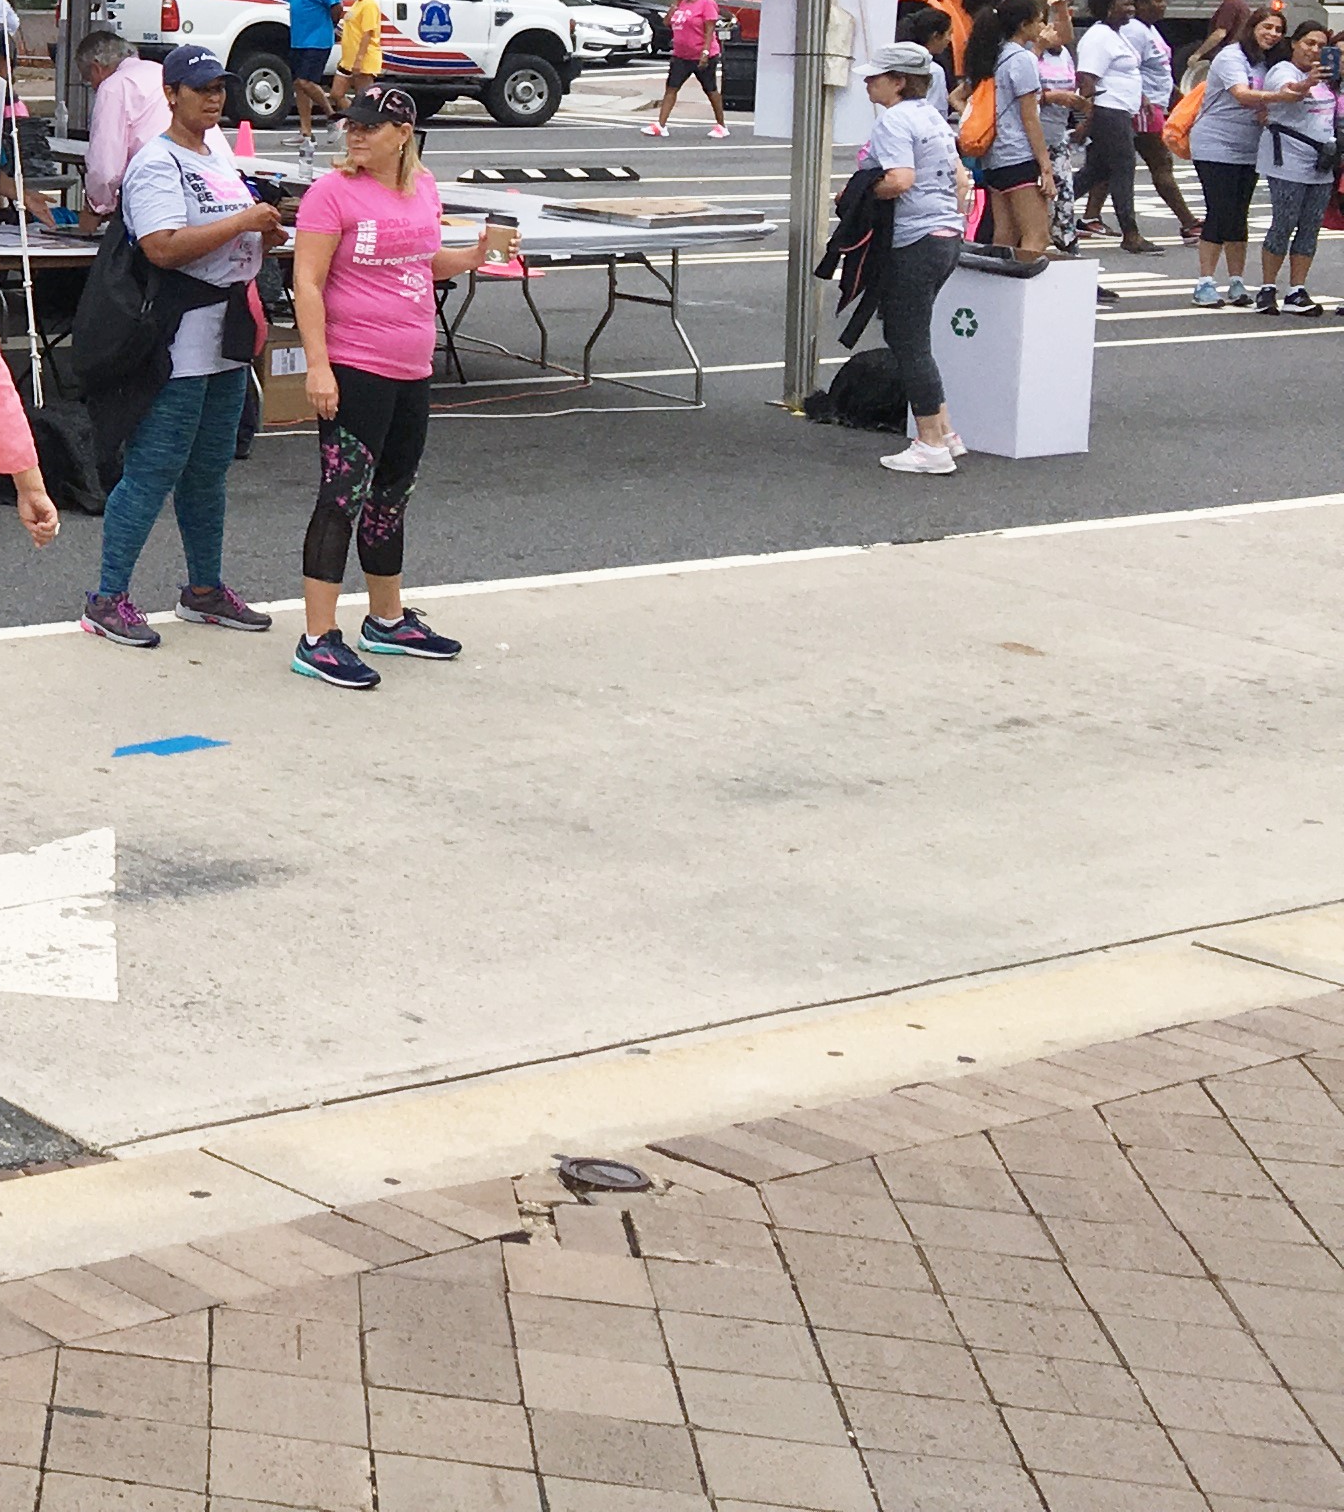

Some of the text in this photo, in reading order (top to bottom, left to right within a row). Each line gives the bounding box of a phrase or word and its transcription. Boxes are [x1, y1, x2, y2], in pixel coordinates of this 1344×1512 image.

[356, 232, 377, 243] BE
[354, 243, 376, 255] BE
[352, 256, 382, 265] RACE
